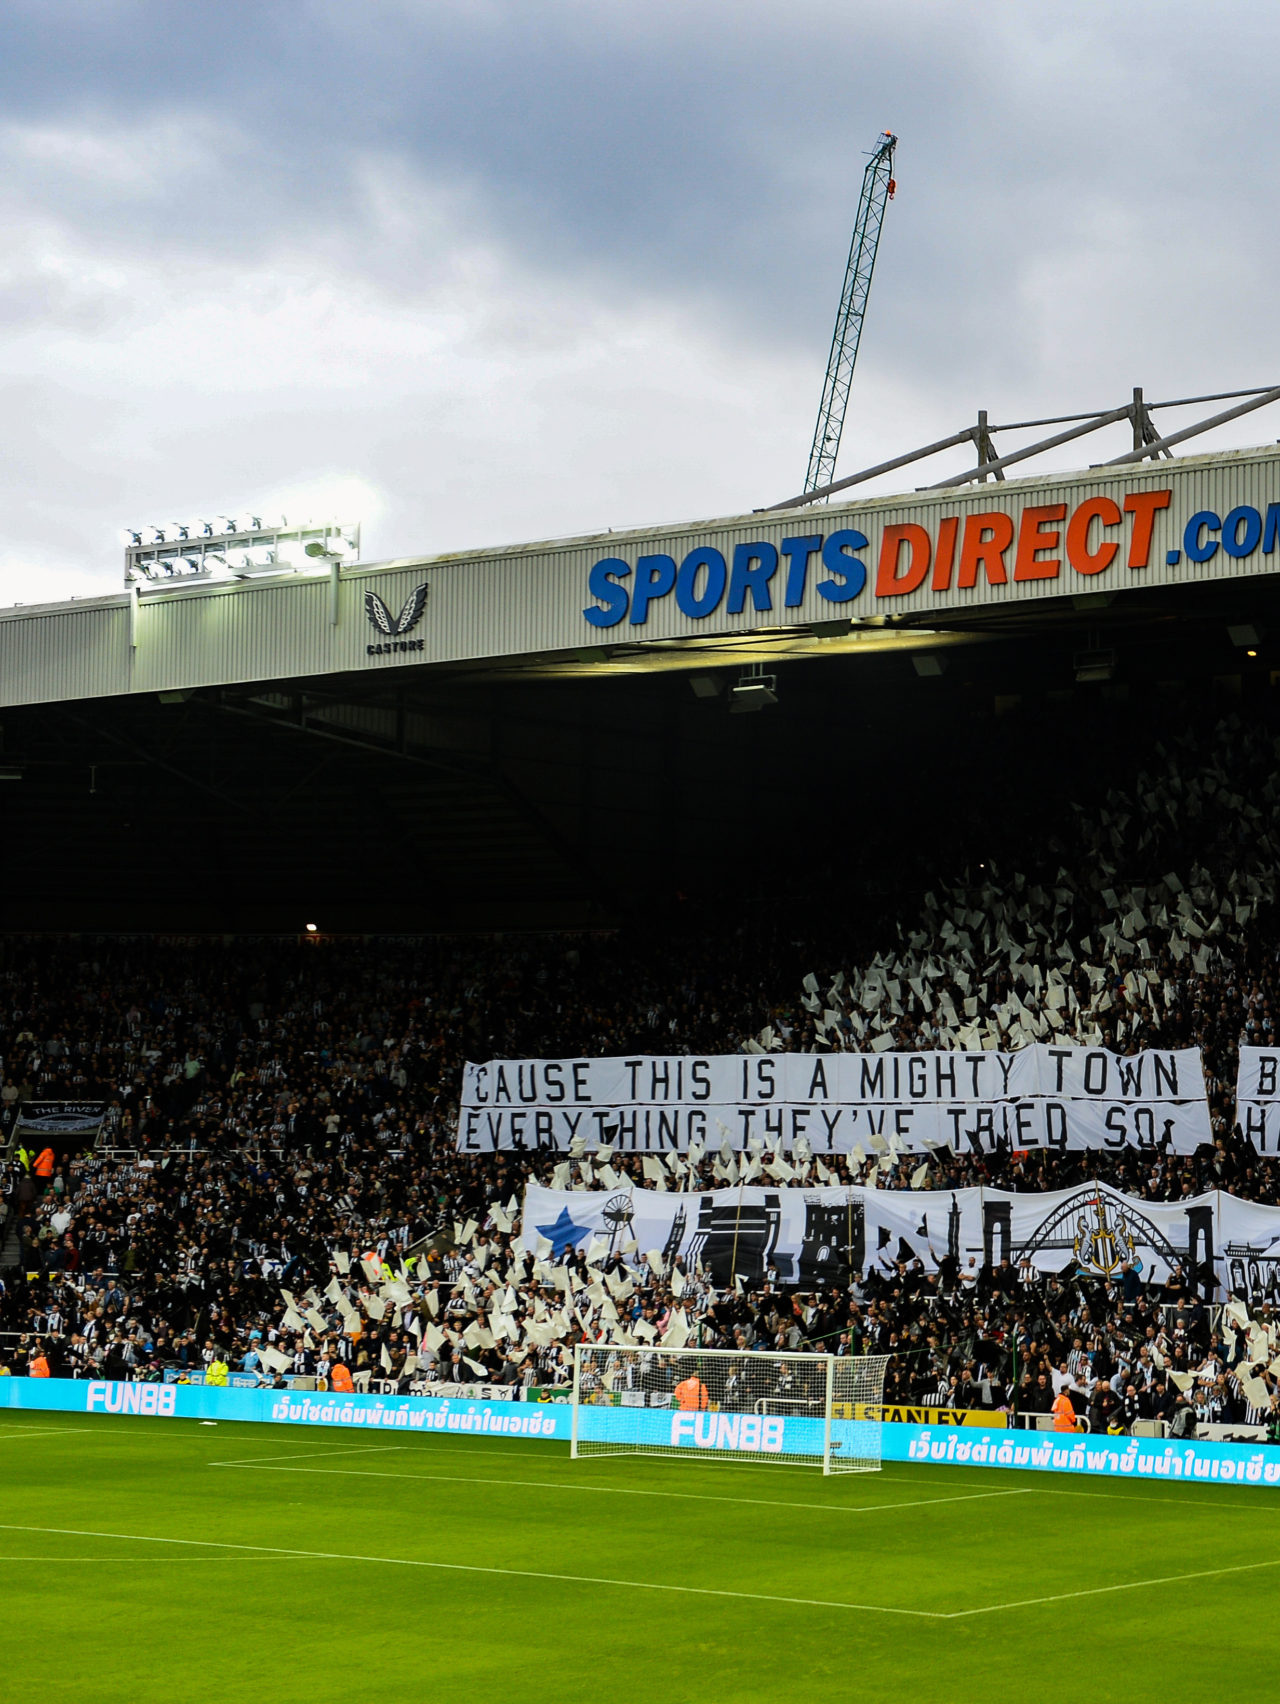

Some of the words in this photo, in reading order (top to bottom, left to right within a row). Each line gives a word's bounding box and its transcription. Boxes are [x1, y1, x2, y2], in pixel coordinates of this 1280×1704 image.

[366, 638, 425, 656] CASTORE
[624, 1060, 711, 1100] THIS
[743, 1058, 775, 1099] IS
[808, 1058, 829, 1099] A
[860, 1054, 1015, 1099] MIGHTY
[1049, 1050, 1179, 1098] TOWN
[86, 1381, 177, 1416] FUN88
[671, 1412, 785, 1452] FUN88
